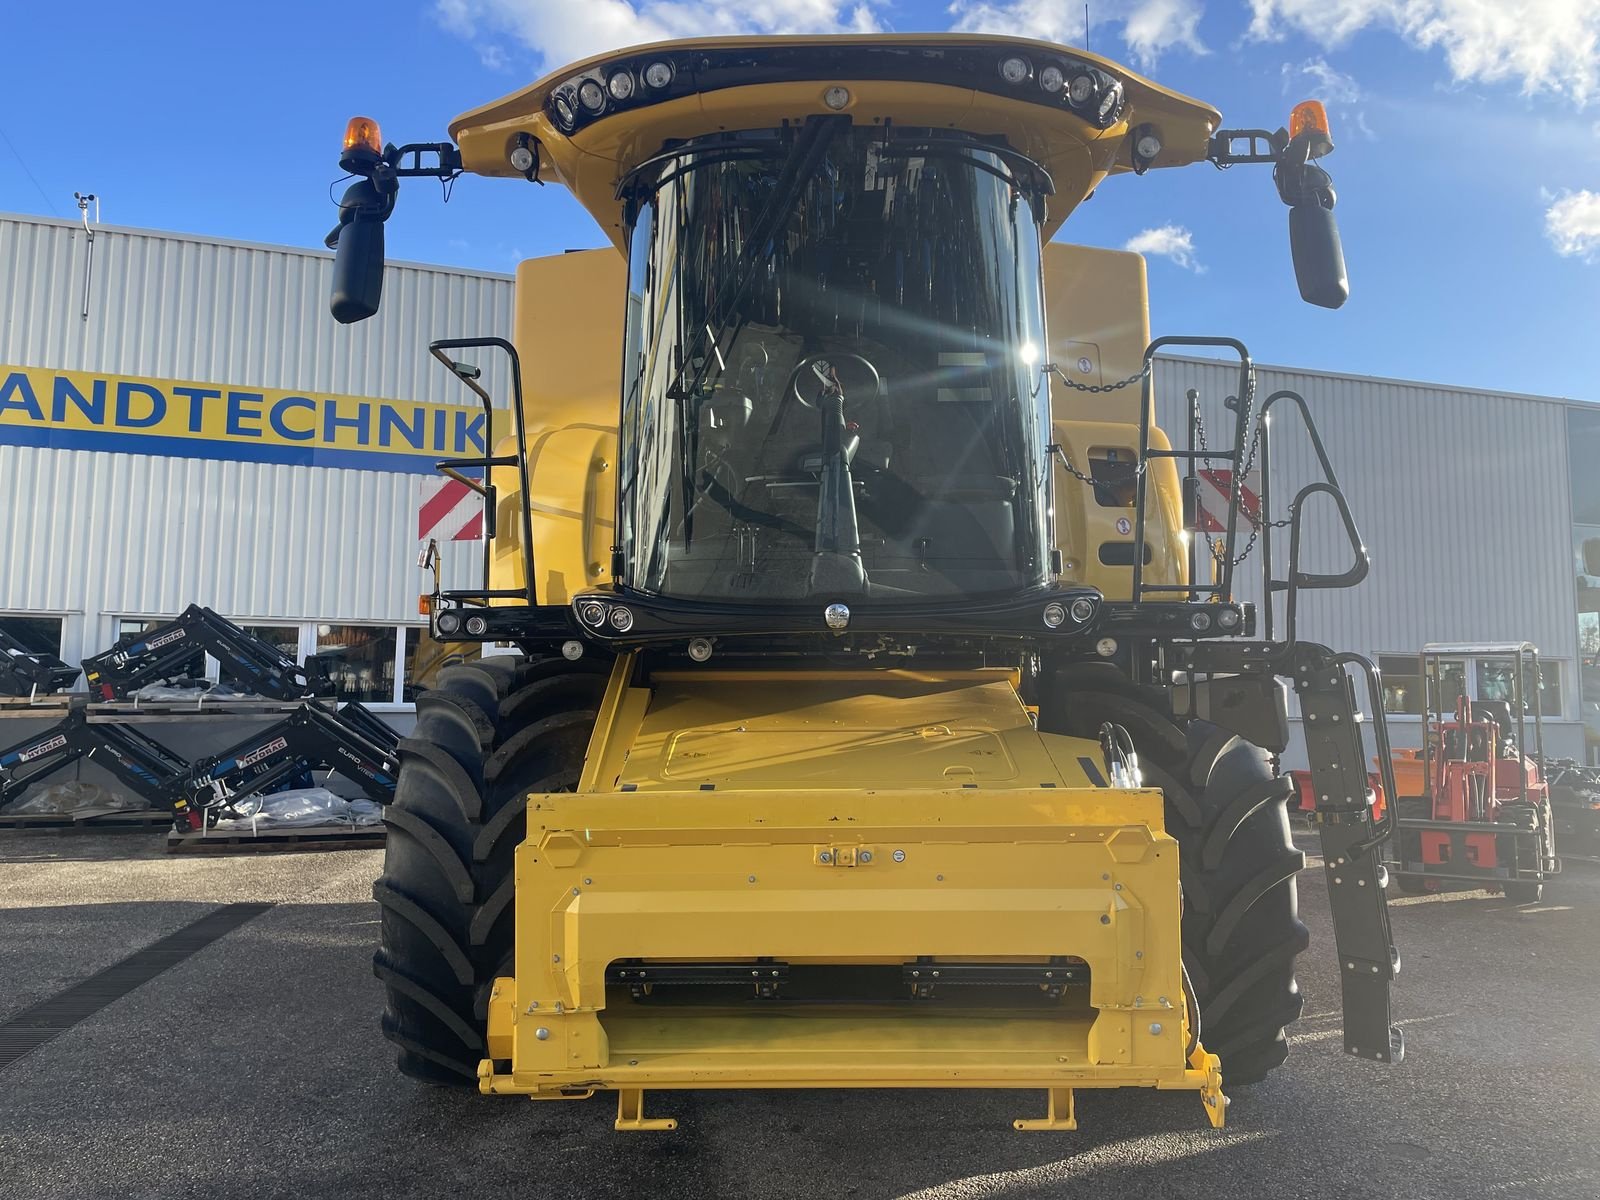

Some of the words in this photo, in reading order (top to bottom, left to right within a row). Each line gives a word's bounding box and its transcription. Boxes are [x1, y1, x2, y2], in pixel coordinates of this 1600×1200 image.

[0, 372, 486, 454] ANDTECHNIK
[27, 739, 65, 757] HYDRAC
[245, 742, 285, 765] HYDRAC
[338, 747, 361, 764] EURO
